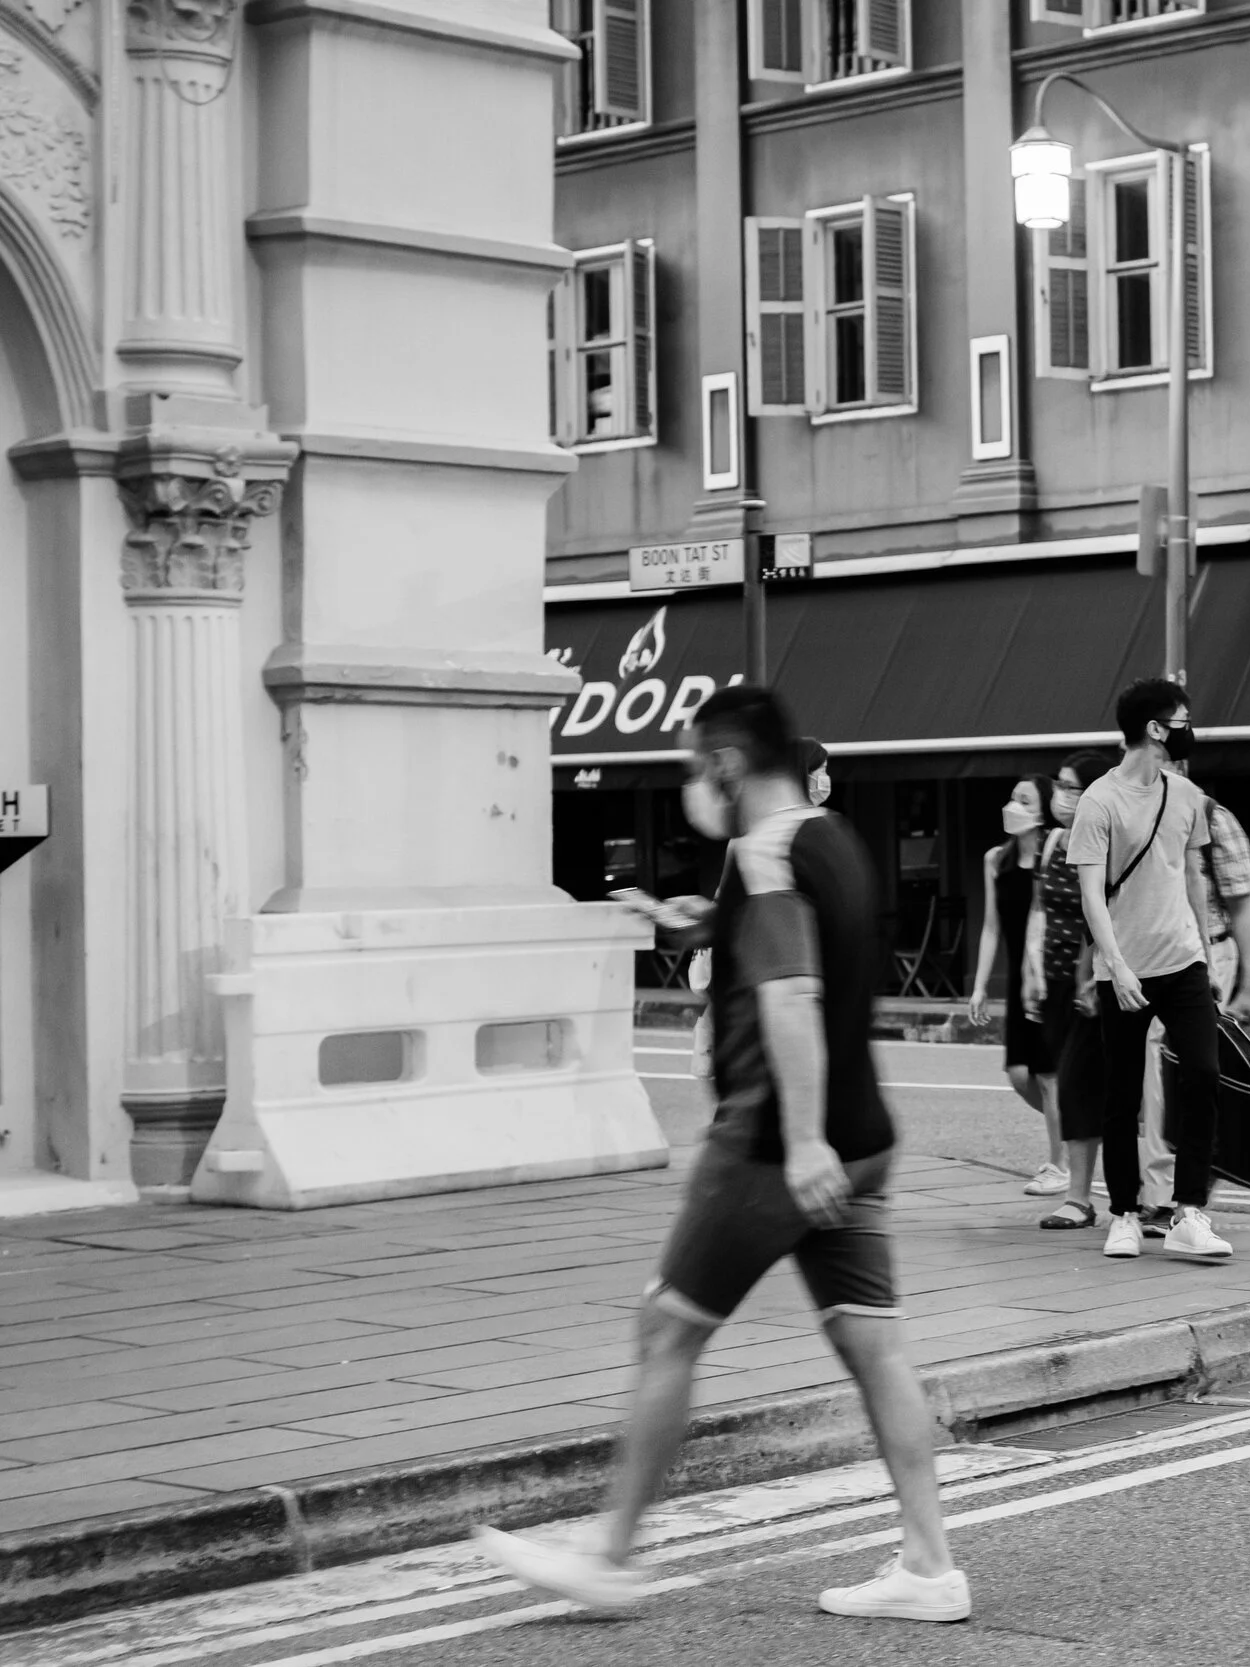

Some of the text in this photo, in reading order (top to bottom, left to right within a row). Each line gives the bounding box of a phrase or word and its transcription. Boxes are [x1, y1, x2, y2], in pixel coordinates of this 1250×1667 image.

[641, 543, 730, 567] BOON TAT ST
[549, 673, 745, 737] DOR
